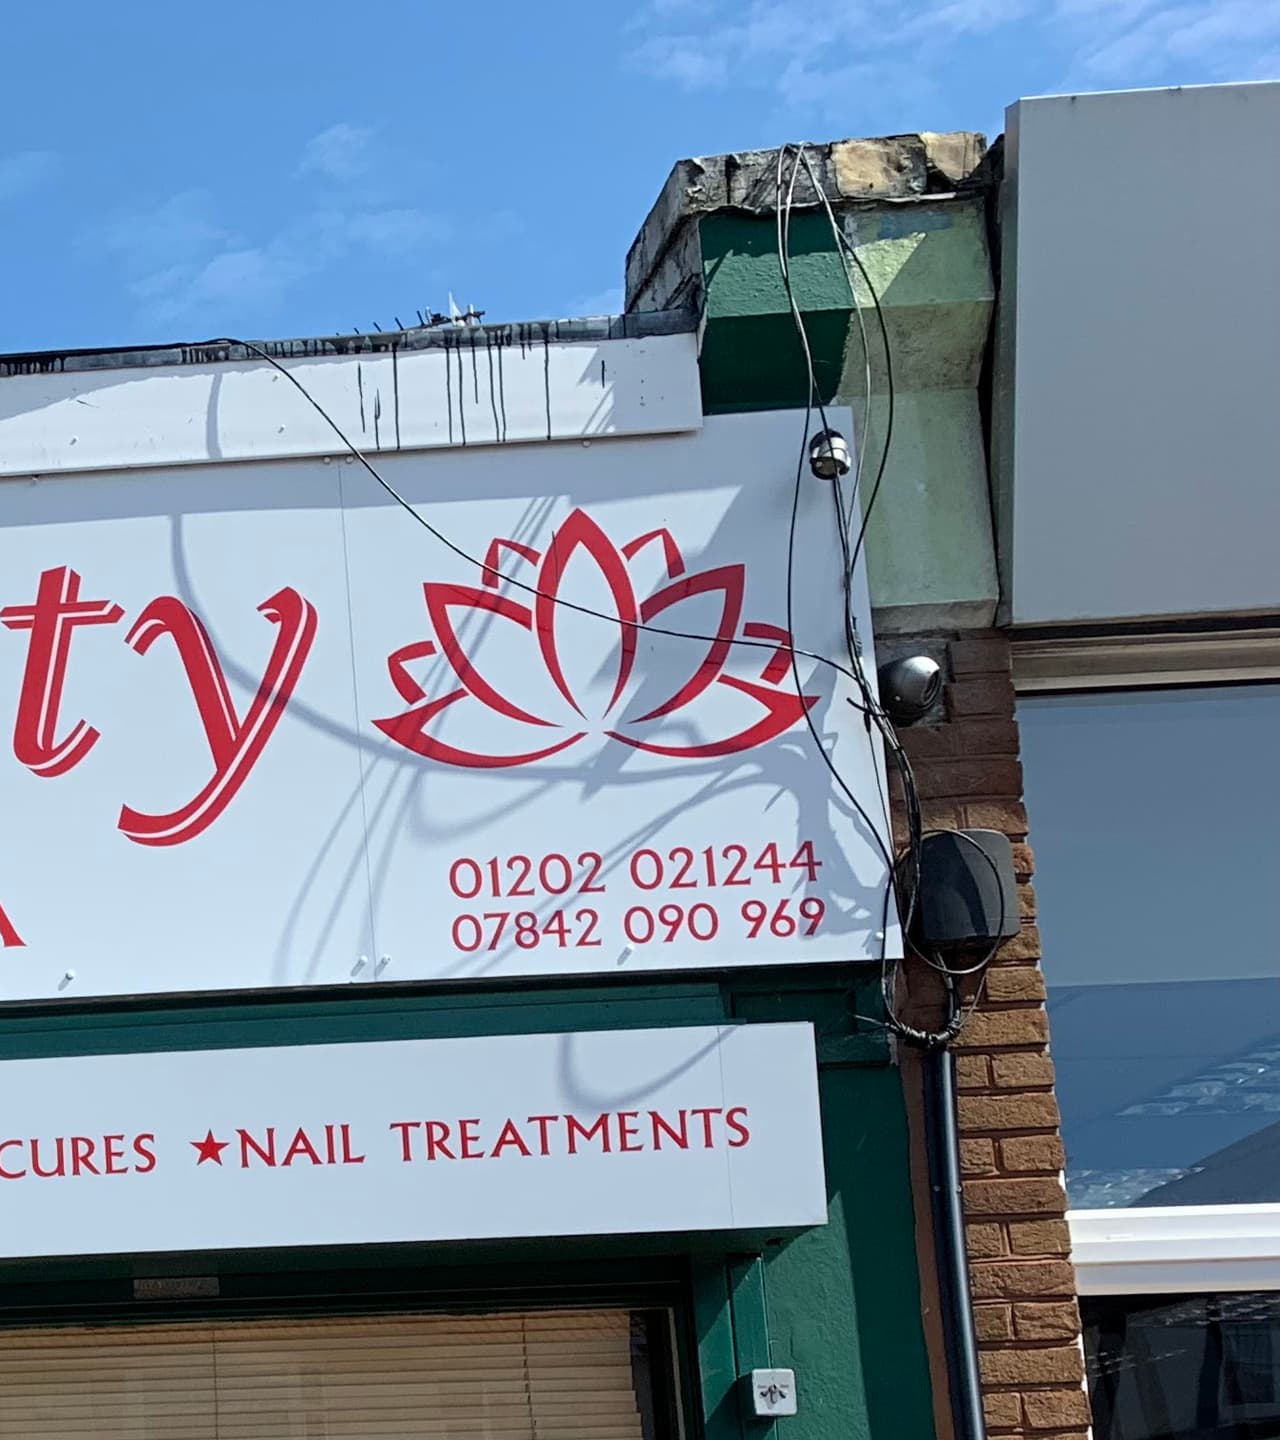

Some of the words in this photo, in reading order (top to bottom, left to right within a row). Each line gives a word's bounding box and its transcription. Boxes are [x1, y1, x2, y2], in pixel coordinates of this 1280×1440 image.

[448, 851, 605, 899] 01202
[629, 841, 823, 890] 021244
[451, 908, 602, 952] 07842
[623, 902, 719, 944] 090
[740, 897, 826, 938] 969
[238, 1123, 365, 1168] NAIL
[391, 1106, 752, 1162] TREATMENTS
